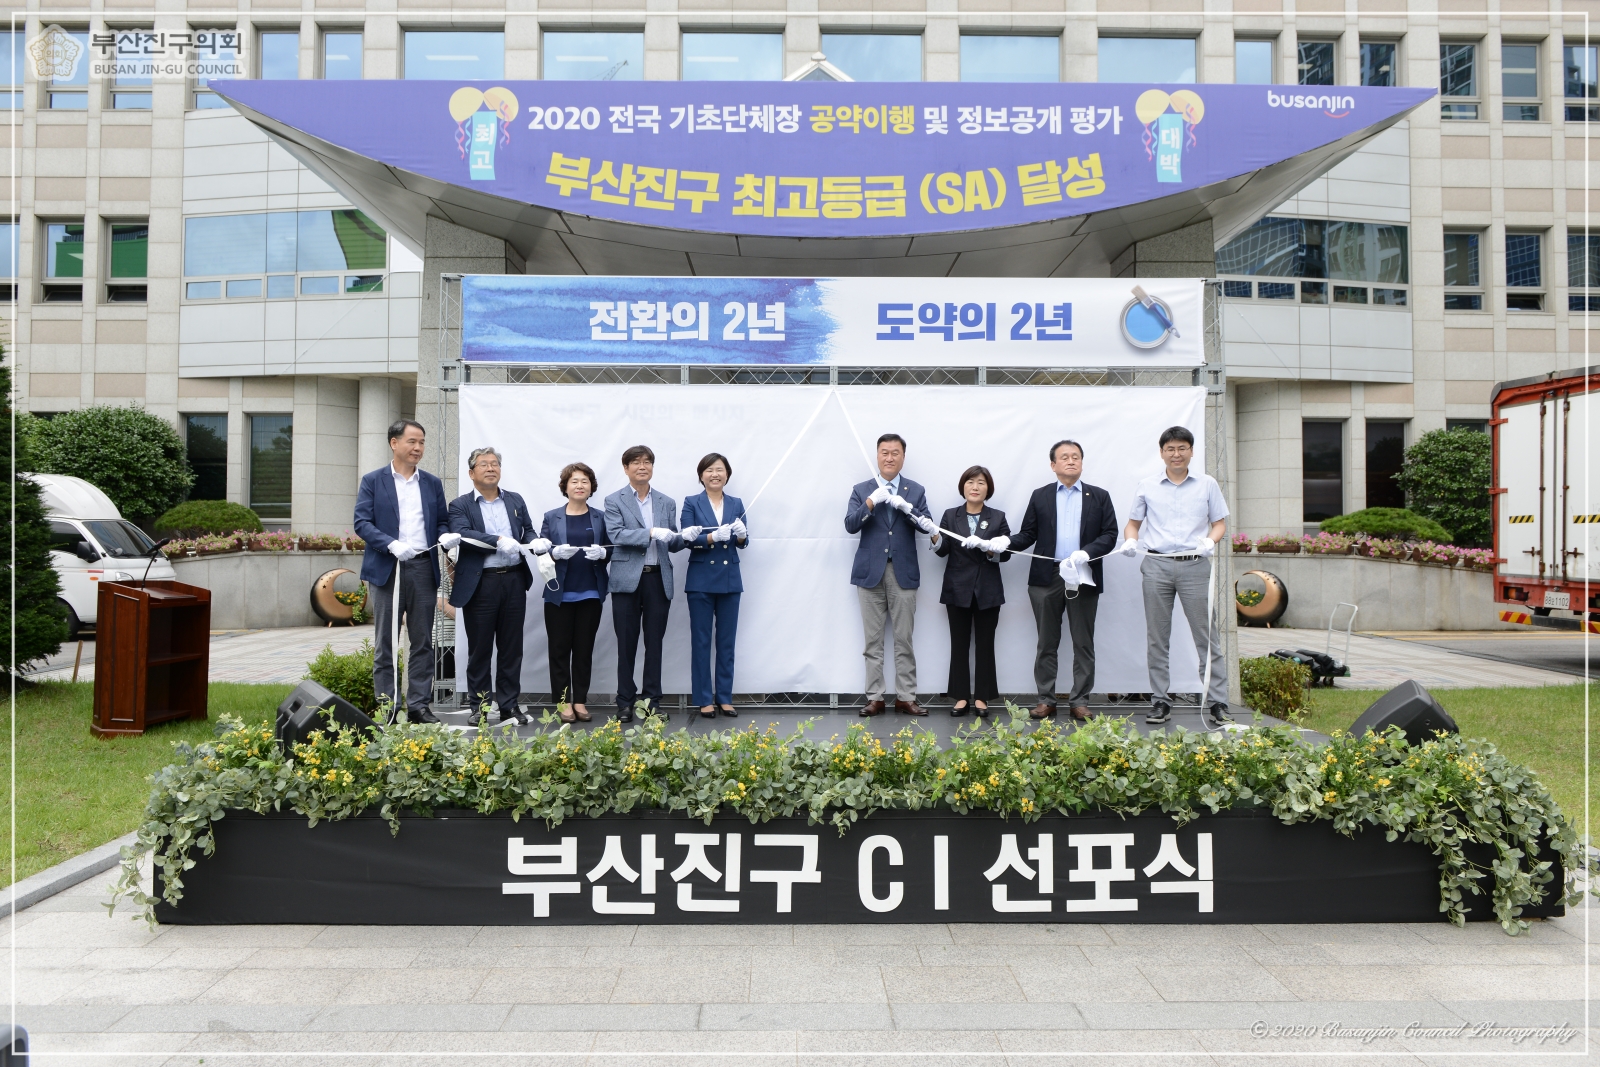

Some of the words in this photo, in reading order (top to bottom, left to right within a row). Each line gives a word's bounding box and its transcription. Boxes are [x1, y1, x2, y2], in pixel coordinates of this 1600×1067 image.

[527, 106, 601, 130] 2020
[608, 104, 662, 134] 전국
[669, 104, 802, 134] 기초단체장
[809, 105, 915, 134] 공약이행
[923, 106, 949, 135] 및
[957, 106, 1062, 135] 정보공개
[1070, 106, 1124, 135] 평가
[1267, 90, 1355, 113] busanjin
[471, 123, 495, 170] 최고
[1160, 127, 1181, 175] 대박
[545, 152, 720, 213] 부산진구
[732, 173, 907, 219] 최고등급
[919, 167, 1007, 214] (SA)
[1017, 152, 1106, 207] 달성
[589, 301, 709, 341] 전환의
[722, 301, 786, 341] 2년
[876, 302, 997, 342] 도약의
[1010, 302, 1073, 341] 2년
[502, 832, 822, 918] 부산진구
[983, 832, 1215, 914] 선포식
